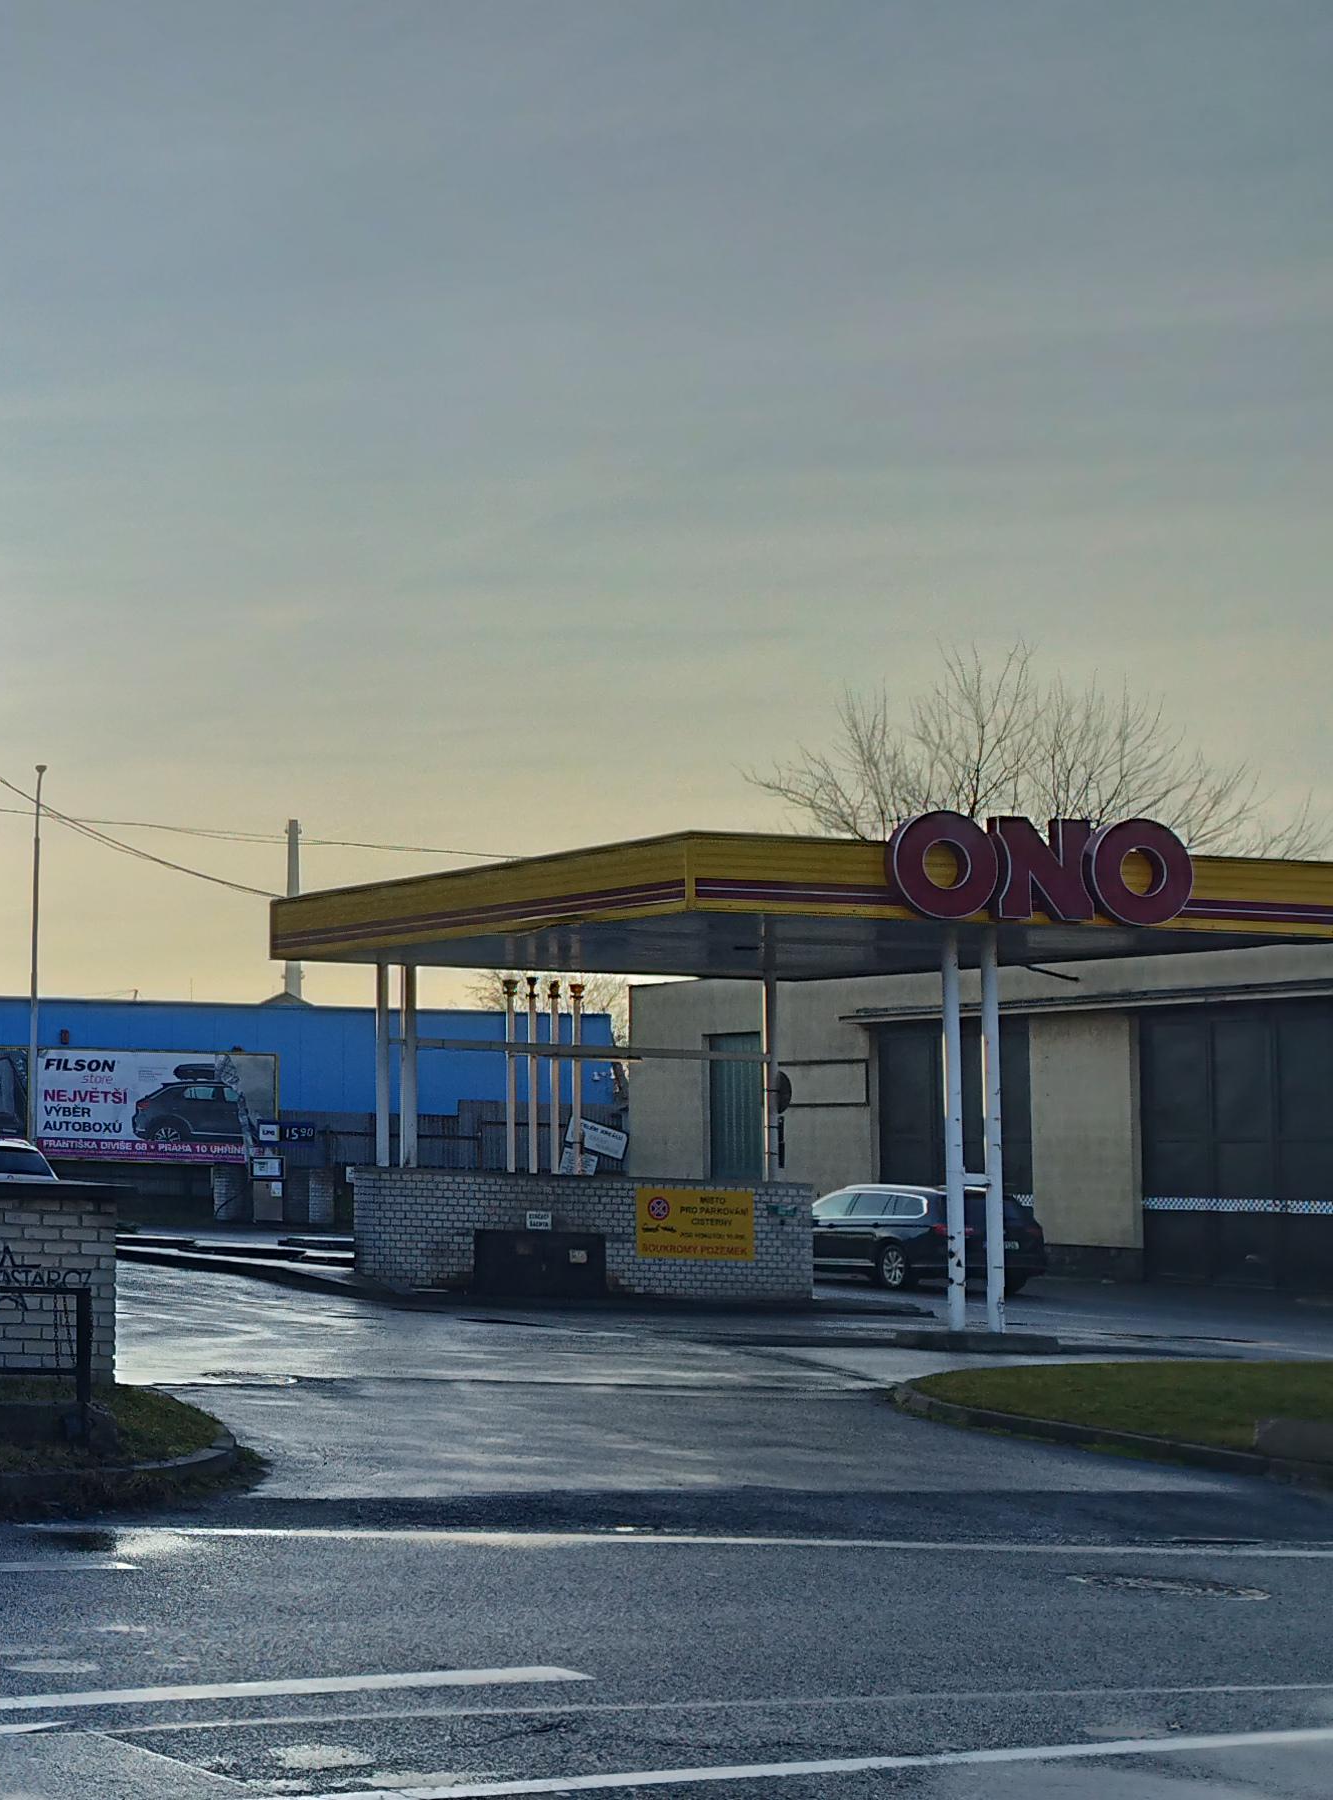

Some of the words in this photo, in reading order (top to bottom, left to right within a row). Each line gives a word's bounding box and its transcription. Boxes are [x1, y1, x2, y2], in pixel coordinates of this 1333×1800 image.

[884, 809, 1194, 927] ONO
[44, 1058, 116, 1073] FILSON
[81, 1074, 113, 1084] store
[44, 1088, 128, 1105] NEJVĚTŠÍ
[44, 1104, 91, 1118] VÝBĚR
[43, 1139, 98, 1149] FRANTIŠKA
[100, 1141, 132, 1151] DIVIŠE
[135, 1142, 147, 1151] 68
[158, 1143, 192, 1153] PRAHA
[195, 1144, 208, 1153] 10
[700, 1196, 726, 1205] MÍSTO
[680, 1206, 698, 1214] PRO
[699, 1207, 748, 1216] PARKOVÁNÍ
[691, 1218, 732, 1227] CISTERNY
[700, 1246, 748, 1256] POZEMEK
